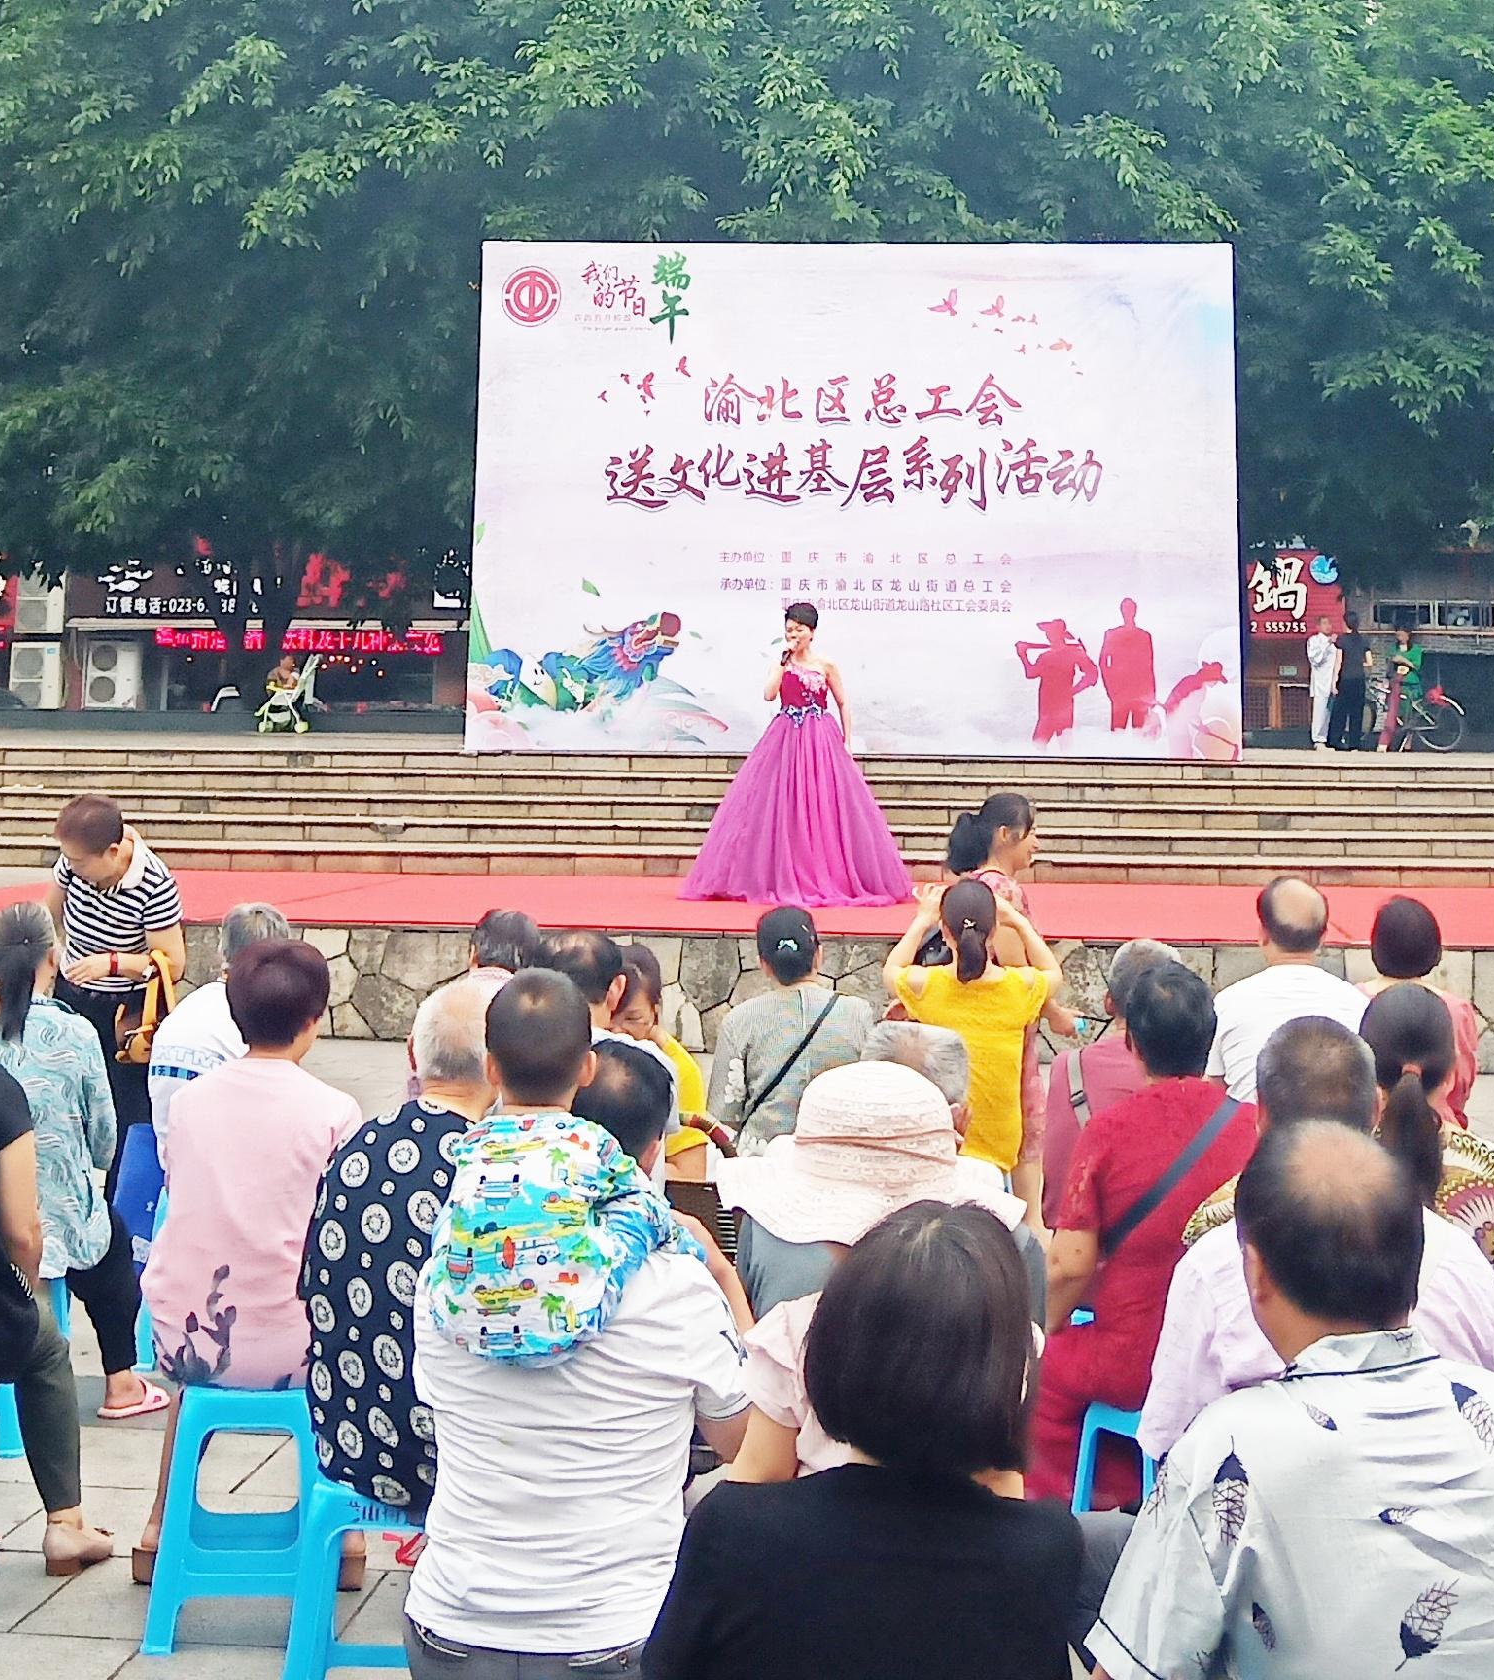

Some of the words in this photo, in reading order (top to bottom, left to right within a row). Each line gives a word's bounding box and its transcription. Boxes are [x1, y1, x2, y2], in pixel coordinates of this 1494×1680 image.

[649, 251, 691, 345] 端午
[704, 372, 1023, 426] 渝北区总工会
[605, 434, 1104, 512] 送文化进基层系列活动
